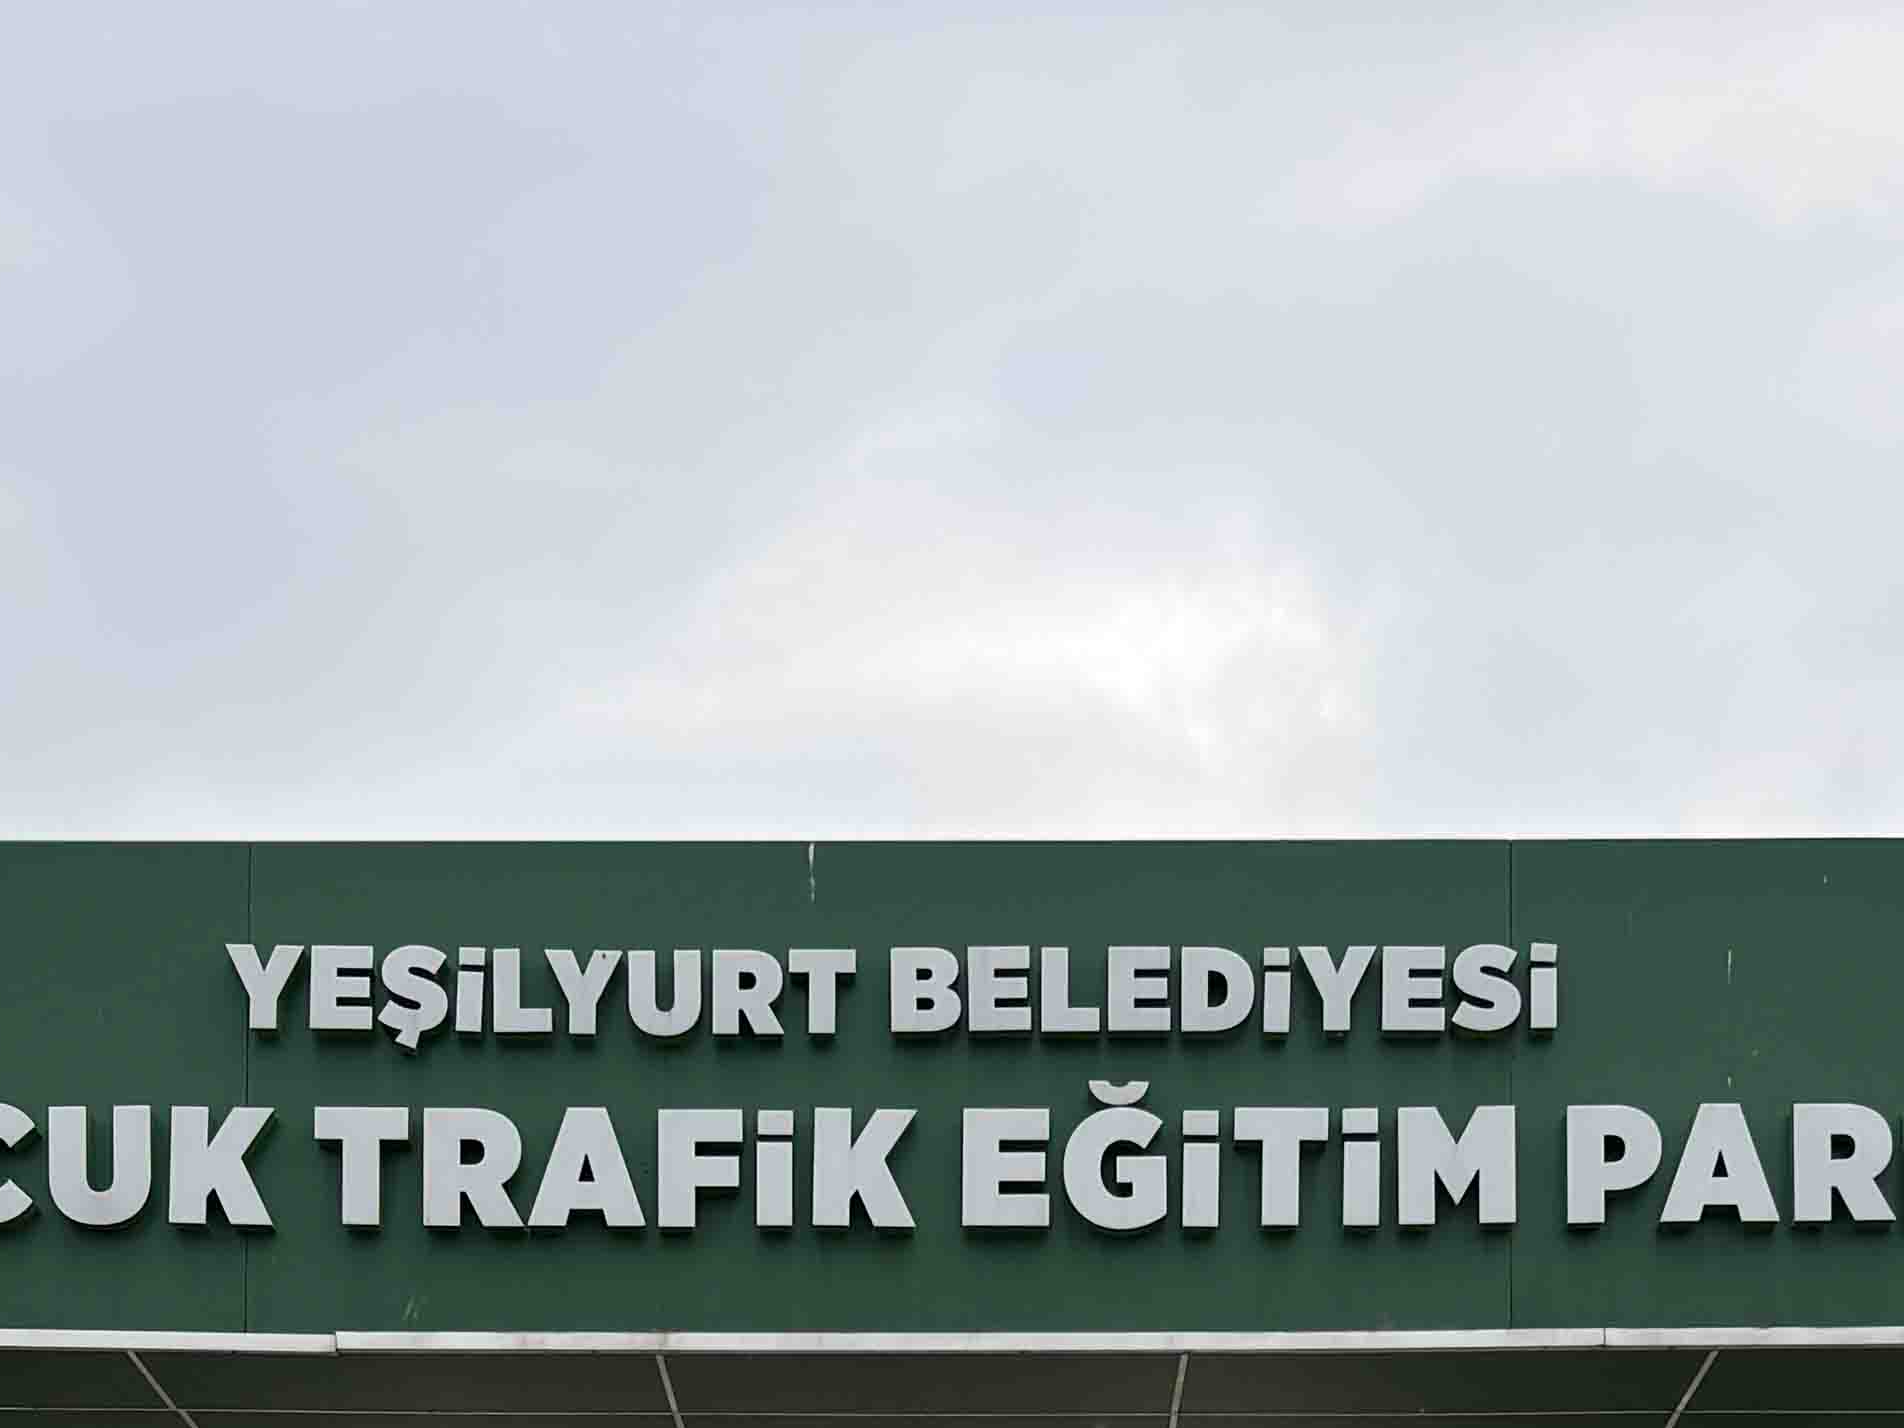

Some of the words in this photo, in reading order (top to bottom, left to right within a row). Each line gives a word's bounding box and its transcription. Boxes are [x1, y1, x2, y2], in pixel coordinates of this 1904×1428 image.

[225, 943, 856, 1051] YEŞİLYURT
[889, 943, 1559, 1034] BELEDİYESİ
[312, 1106, 918, 1229] TRAFİK
[961, 1080, 1517, 1231] EĞİTİM
